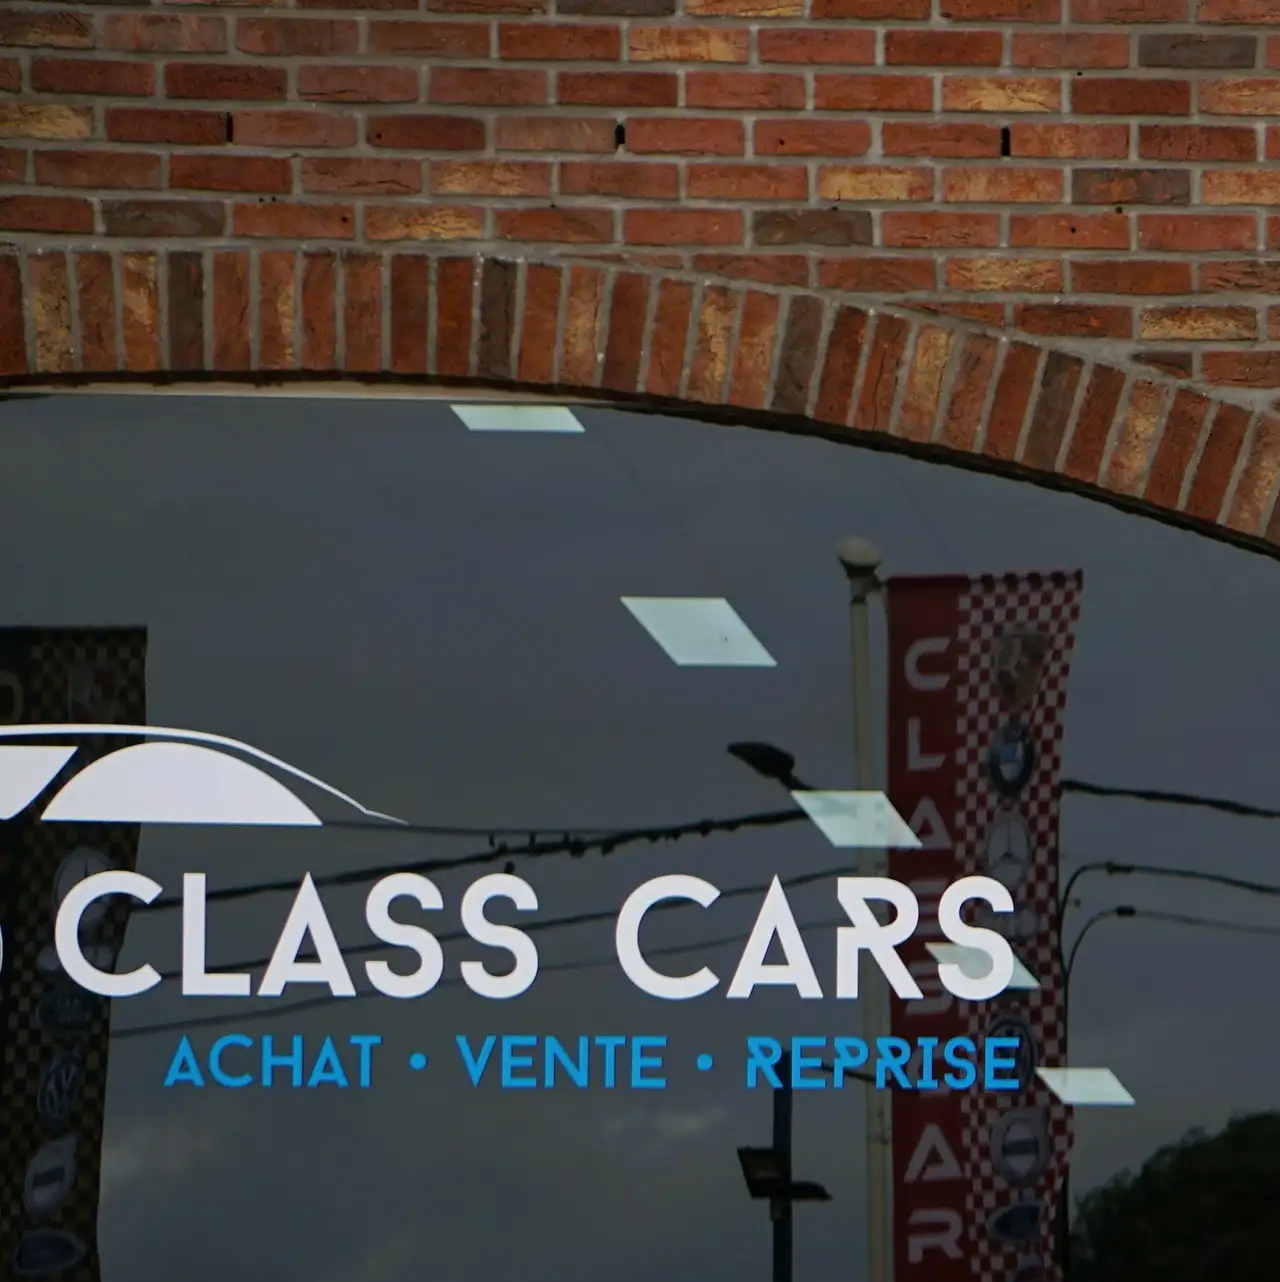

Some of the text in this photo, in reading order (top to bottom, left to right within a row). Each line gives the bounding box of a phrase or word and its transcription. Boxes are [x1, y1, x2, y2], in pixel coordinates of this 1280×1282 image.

[55, 871, 1015, 1000] CLASS CARS
[163, 1033, 1021, 1091] ACHAT VENTE REPRISE
